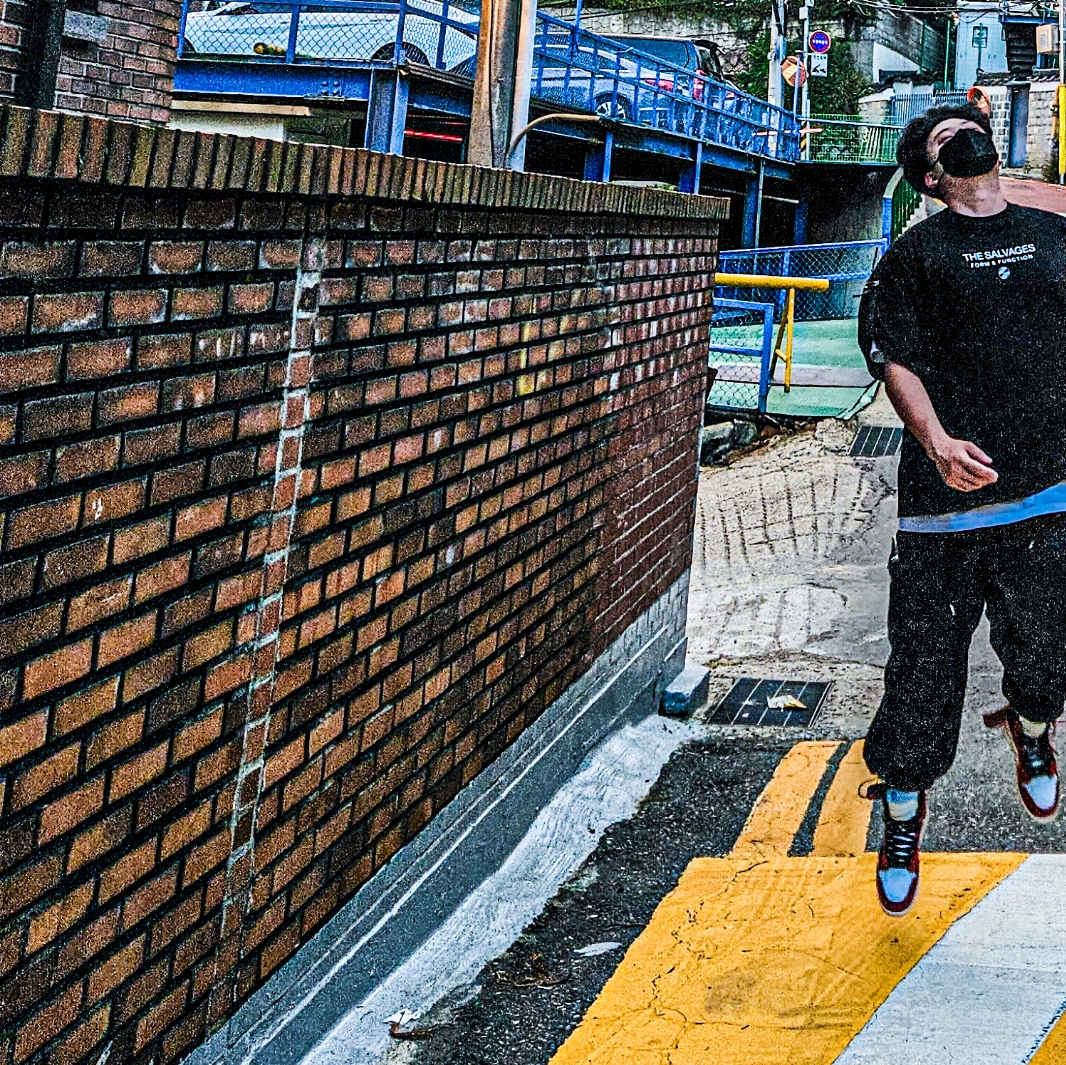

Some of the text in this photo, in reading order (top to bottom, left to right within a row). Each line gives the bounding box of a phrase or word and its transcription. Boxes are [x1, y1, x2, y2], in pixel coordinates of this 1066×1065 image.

[962, 243, 1036, 262] THE SALVAGES
[997, 254, 1033, 264] FUNCTION
